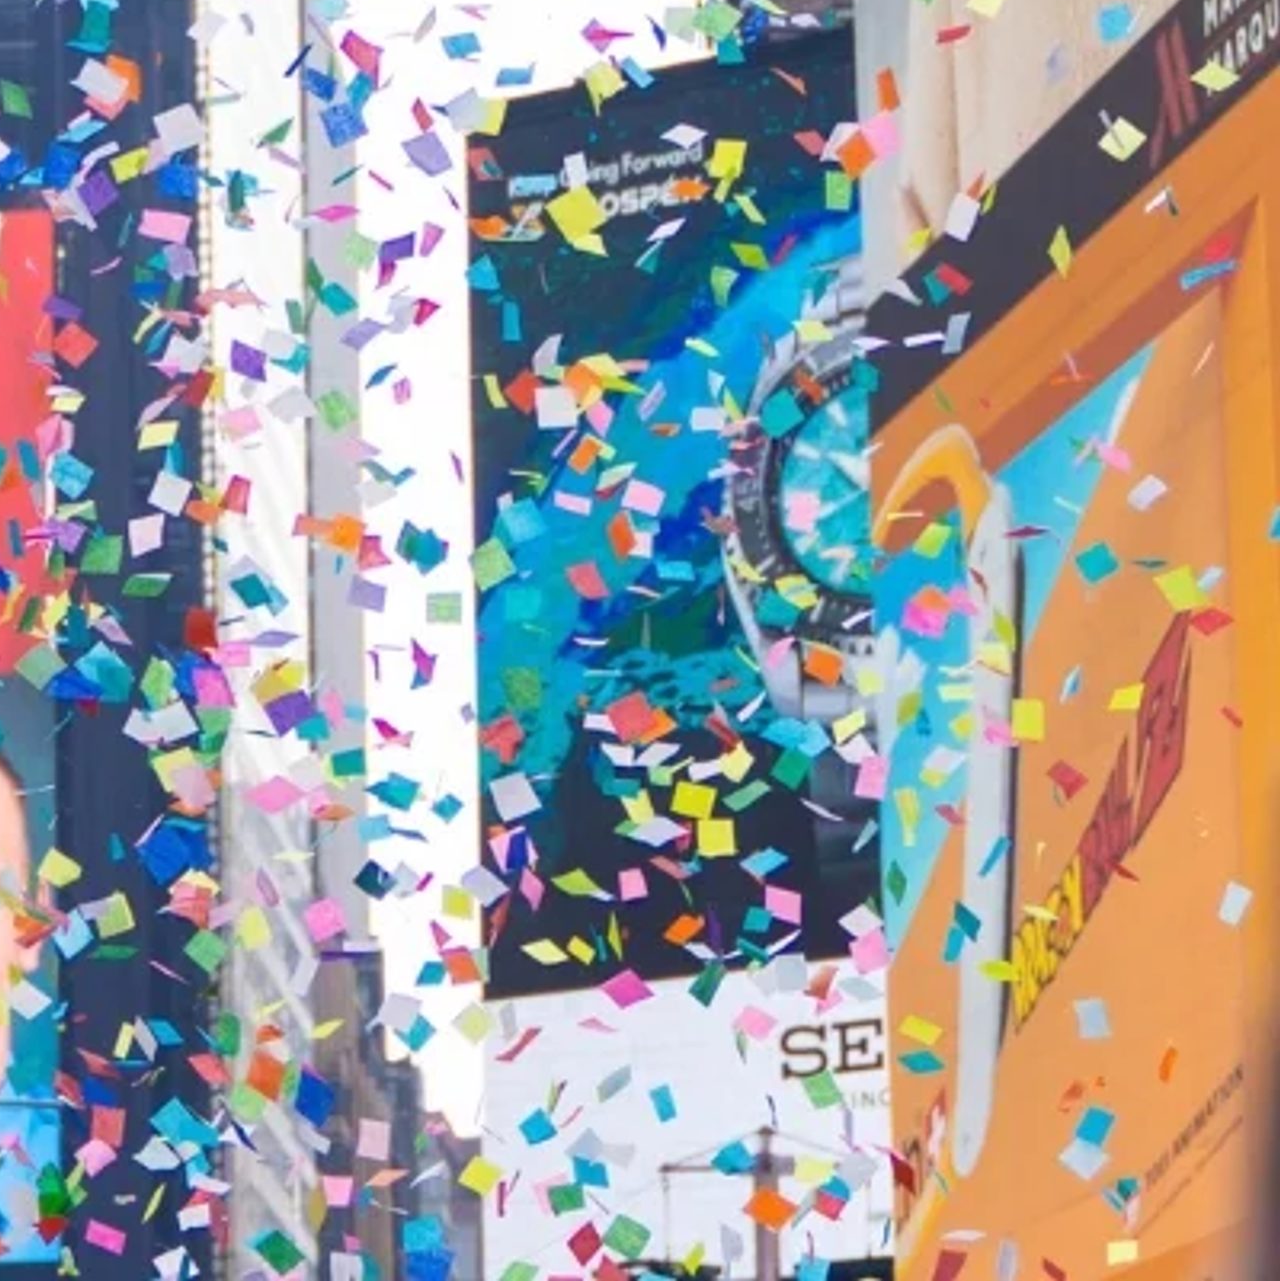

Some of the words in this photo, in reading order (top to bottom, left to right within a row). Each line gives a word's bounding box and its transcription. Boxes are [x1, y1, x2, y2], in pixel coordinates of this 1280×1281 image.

[559, 160, 620, 186] Ging
[621, 141, 704, 177] Forward
[590, 173, 703, 219] OSPE
[780, 1017, 885, 1081] SE
